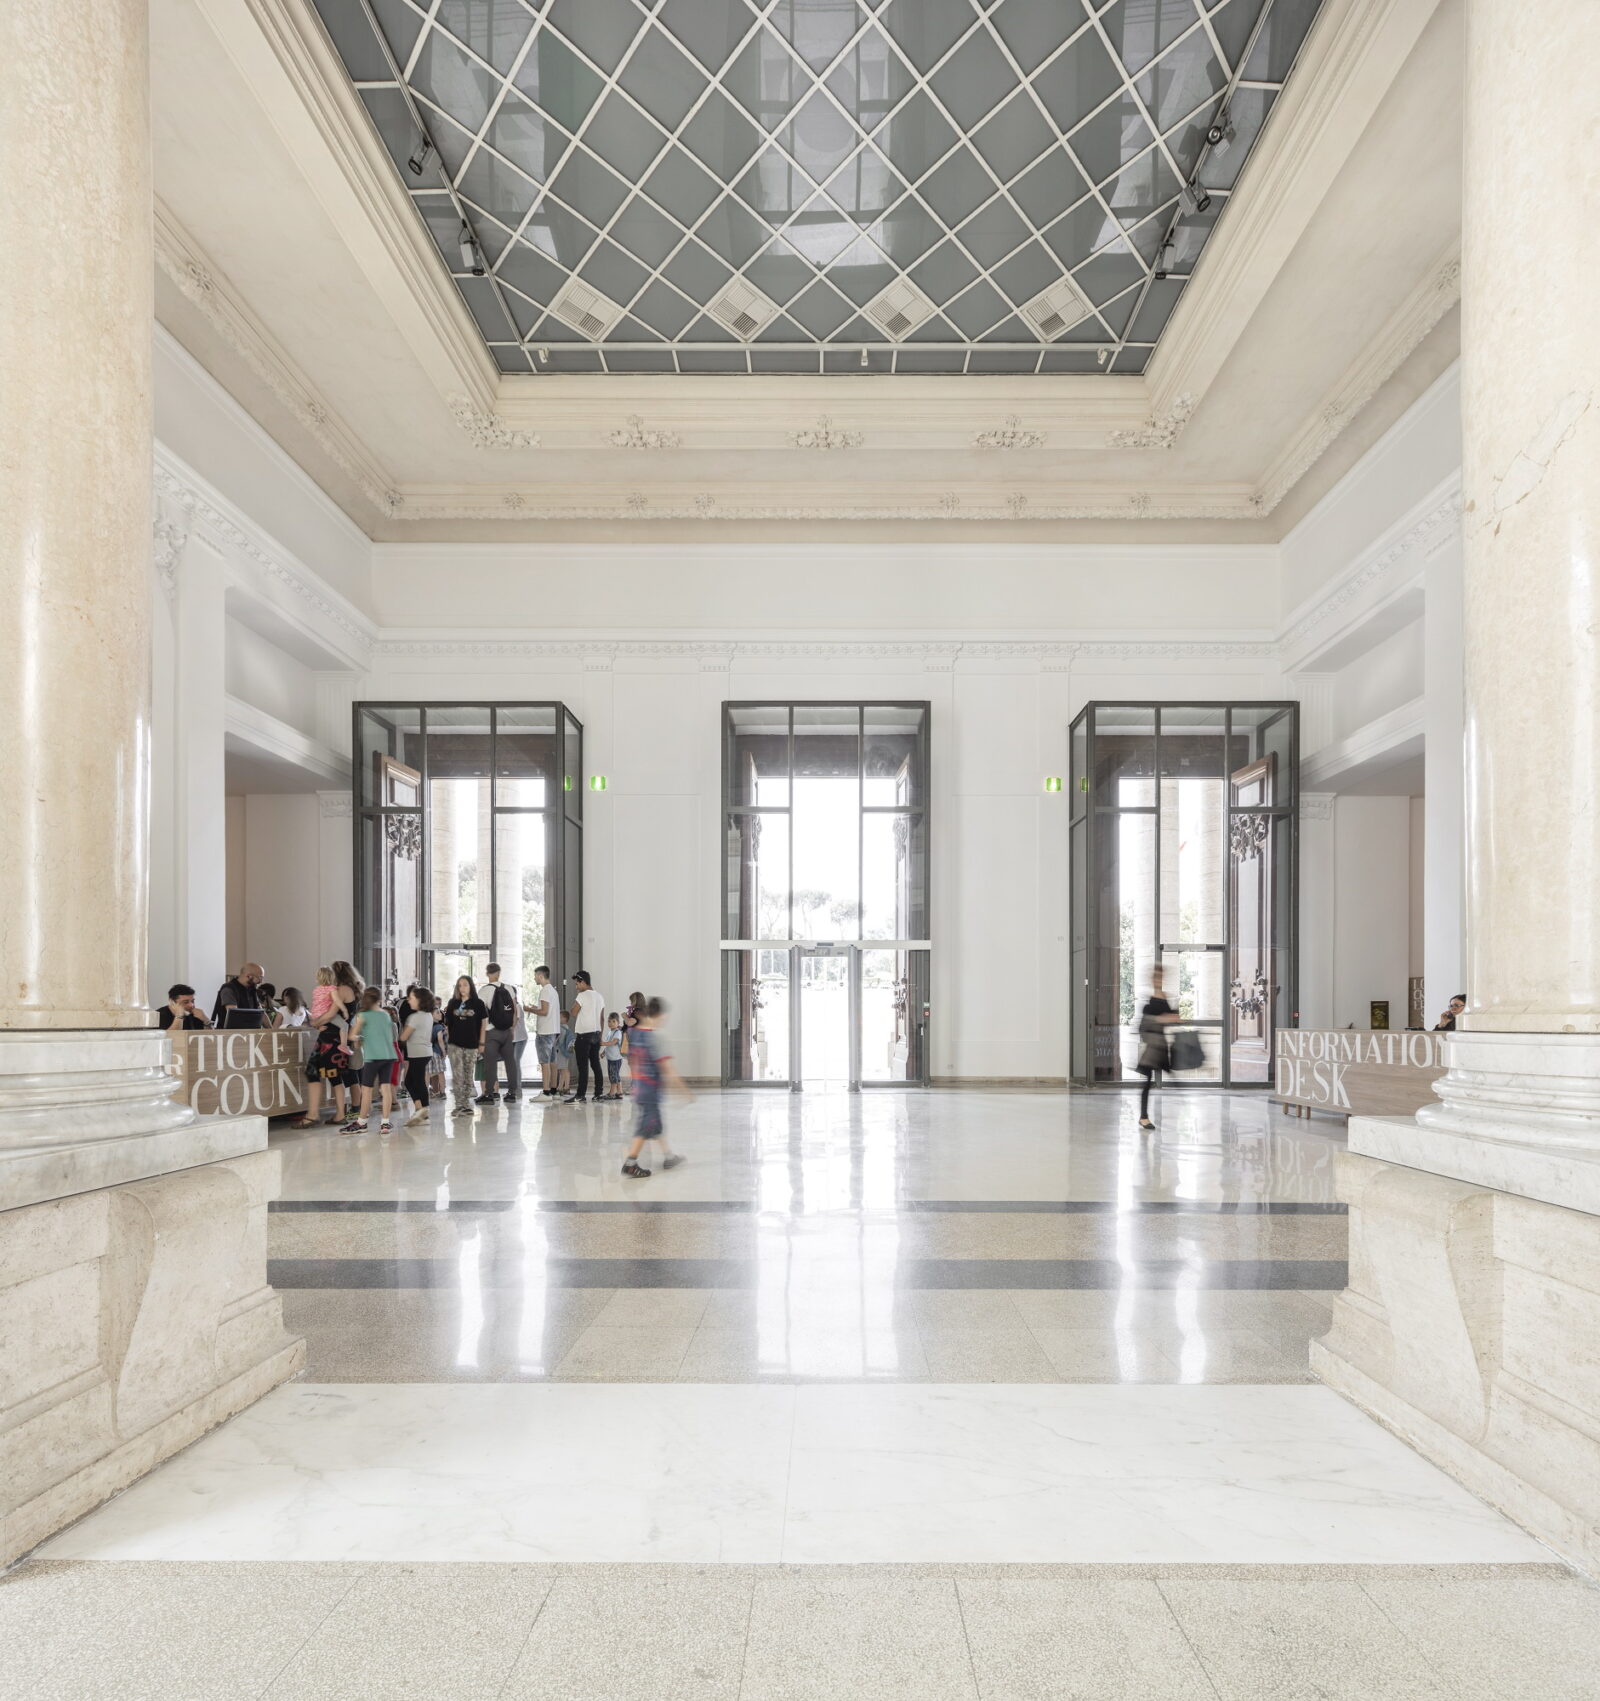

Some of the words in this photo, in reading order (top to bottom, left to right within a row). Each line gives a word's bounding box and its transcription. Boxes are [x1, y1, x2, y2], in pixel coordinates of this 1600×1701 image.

[188, 1031, 310, 1073] TICKET
[191, 1066, 307, 1116] COUN
[1277, 1057, 1352, 1108] DESK
